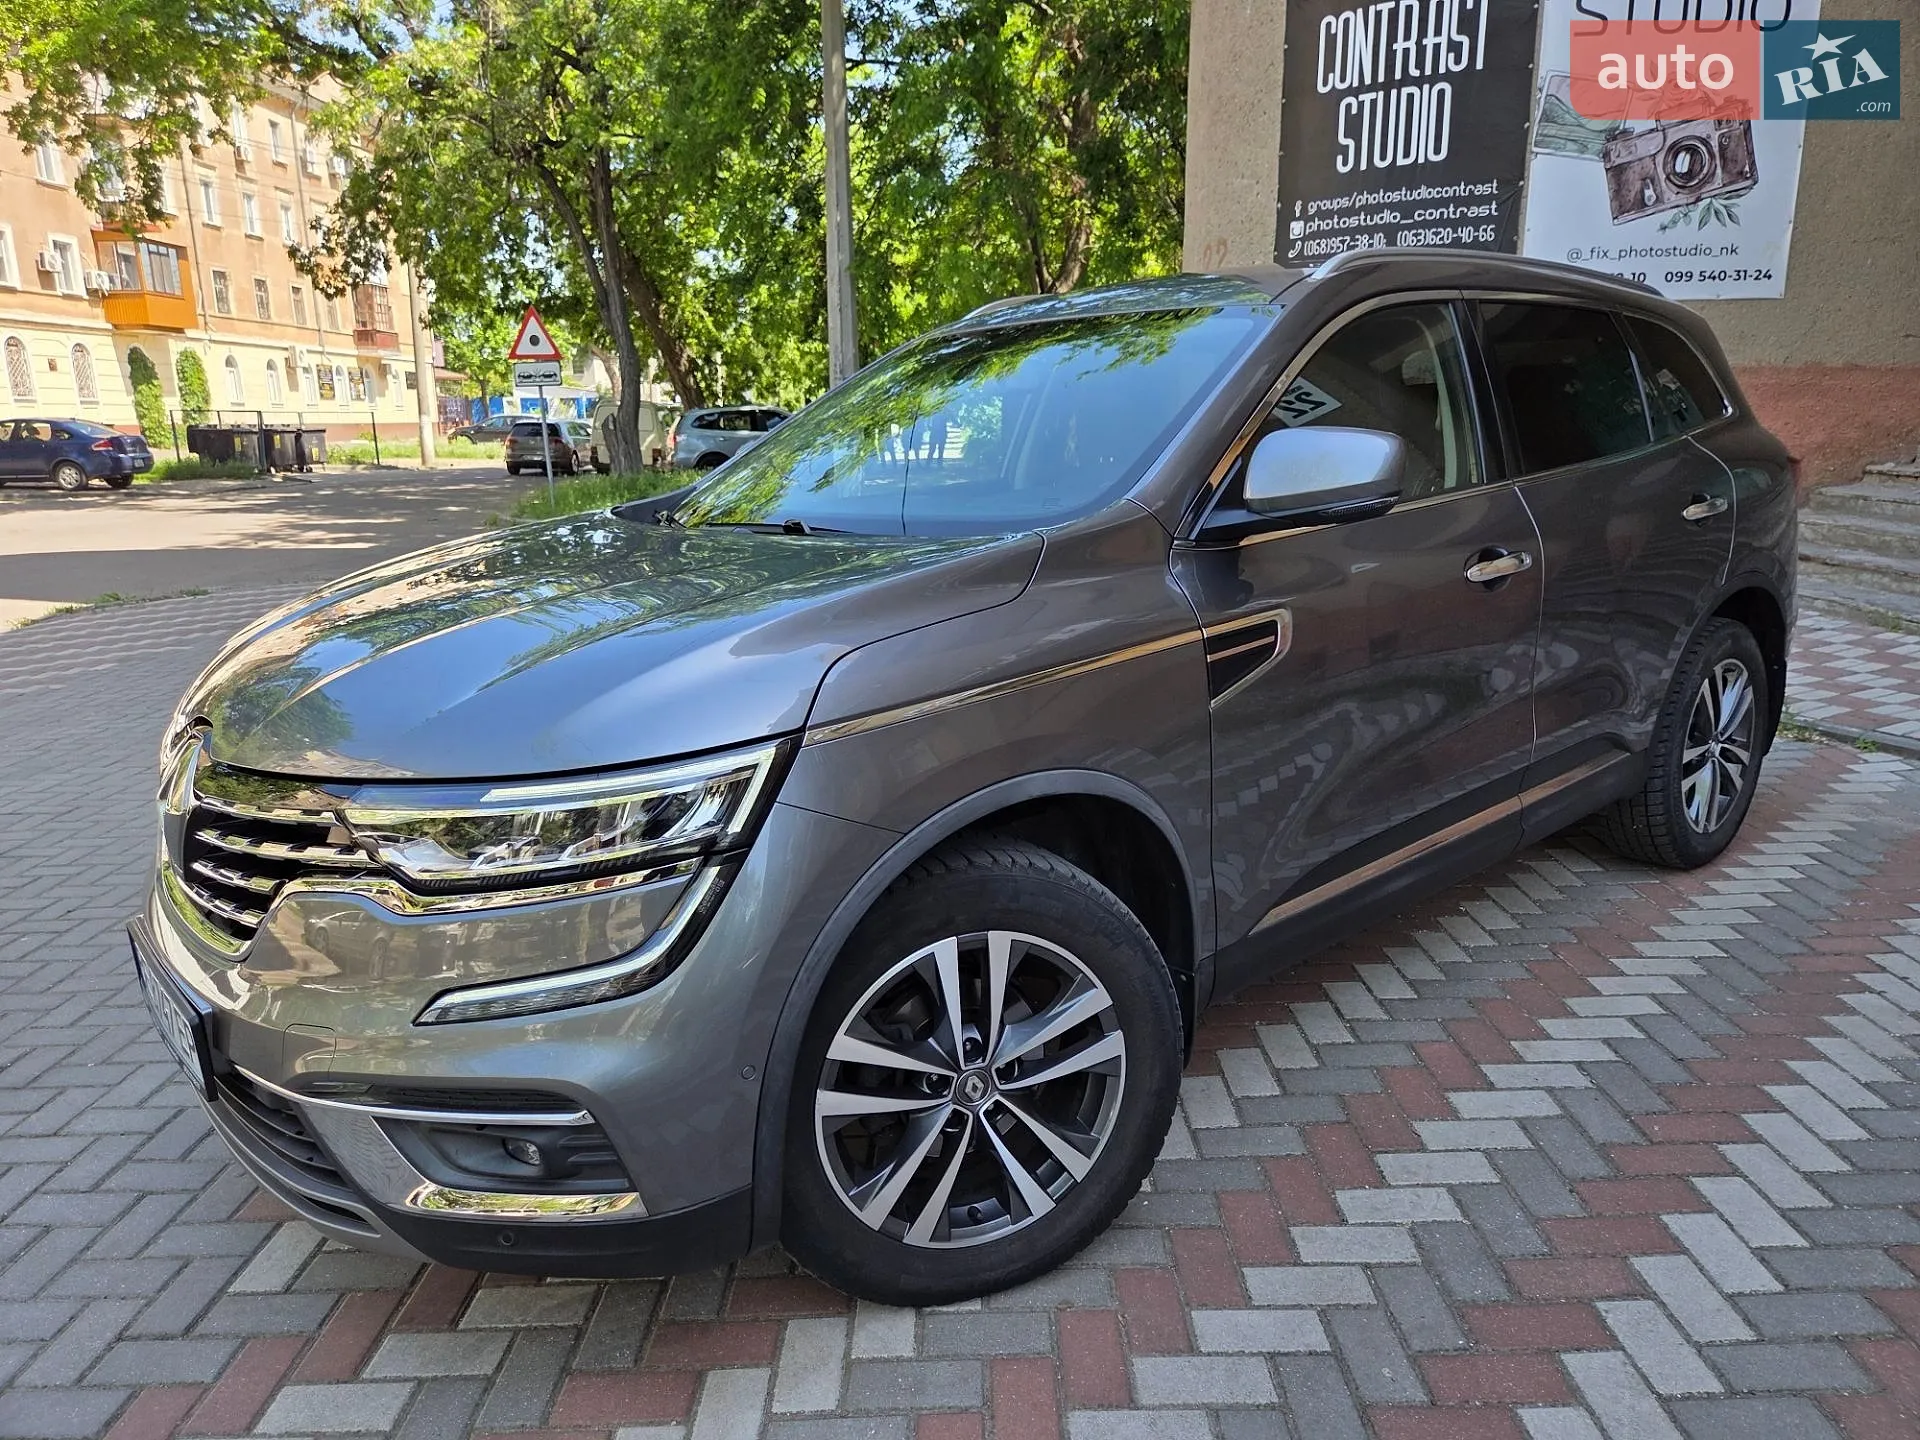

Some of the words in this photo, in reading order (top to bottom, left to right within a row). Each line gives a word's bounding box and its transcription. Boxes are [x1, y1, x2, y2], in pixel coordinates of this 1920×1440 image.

[1317, 0, 1488, 93] CONTRAST
[1336, 82, 1453, 173] STUDIO
[1305, 201, 1499, 236] photostudio_contrast
[1567, 243, 1739, 263] @_fix_photostudio_nk
[1664, 270, 1694, 283] 099
[1697, 269, 1773, 282] 540-31-24
